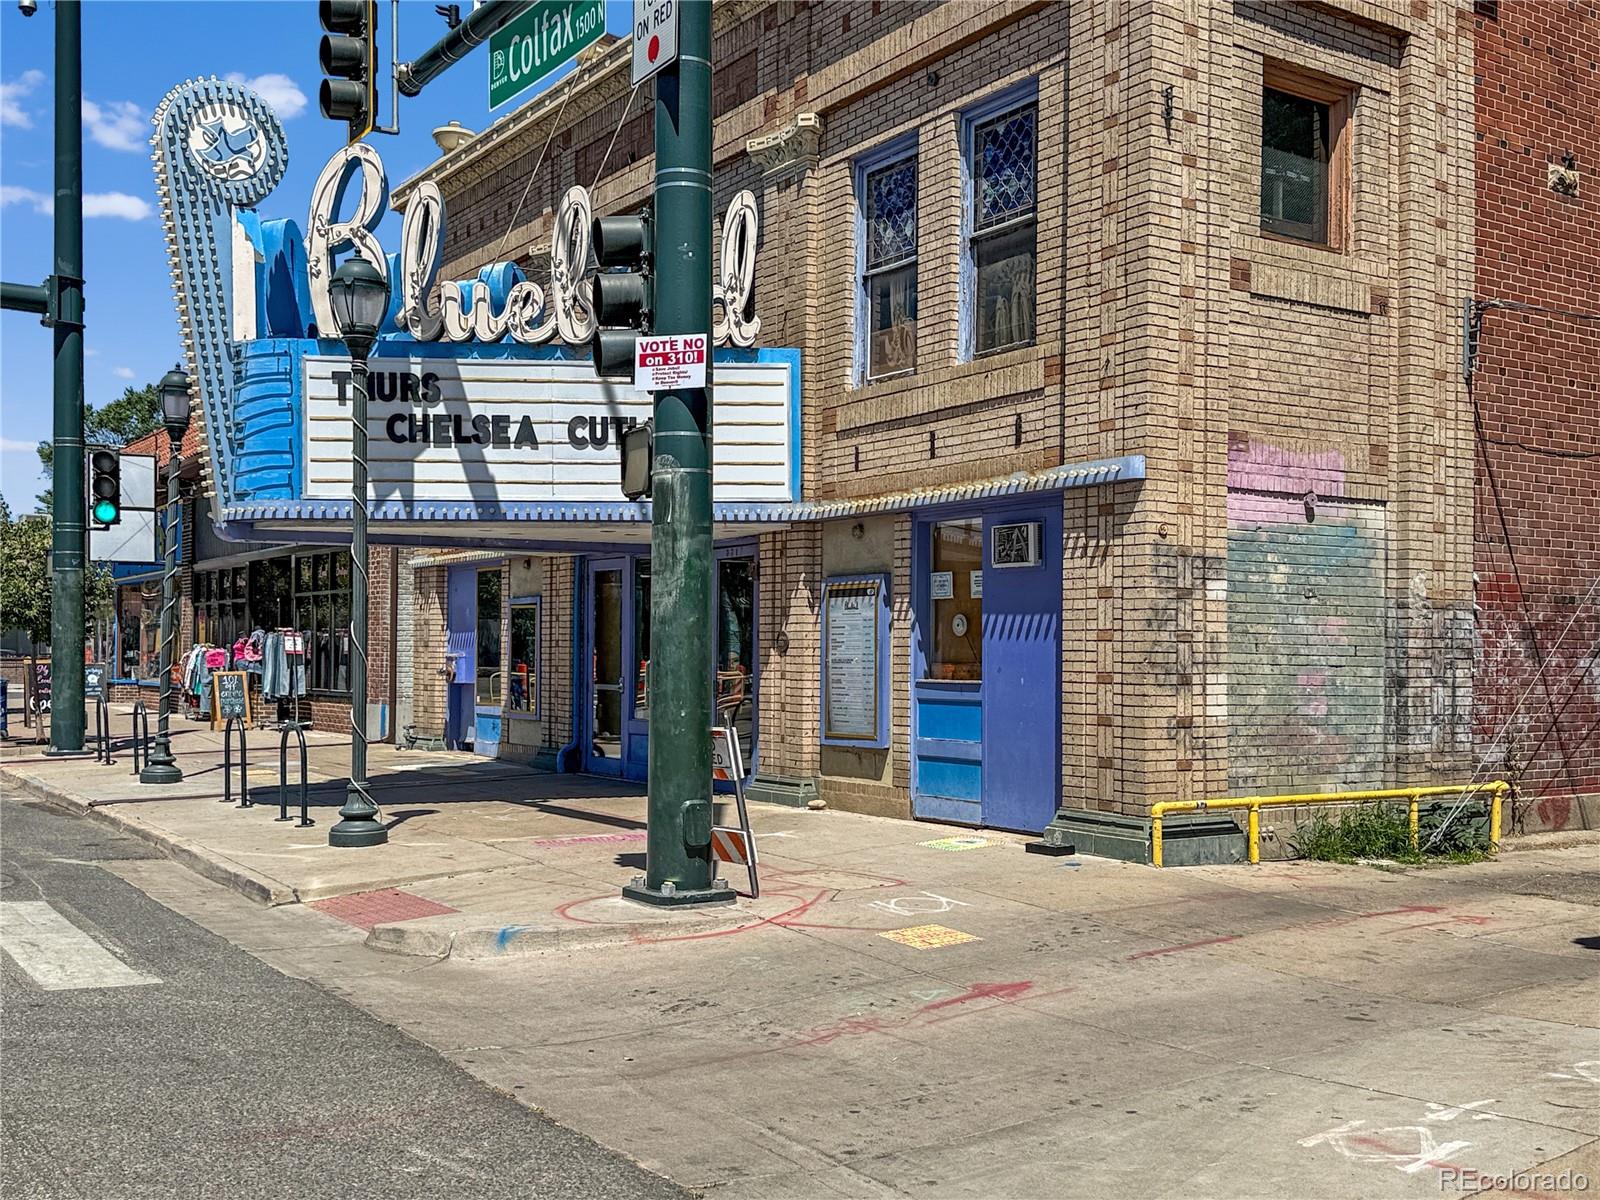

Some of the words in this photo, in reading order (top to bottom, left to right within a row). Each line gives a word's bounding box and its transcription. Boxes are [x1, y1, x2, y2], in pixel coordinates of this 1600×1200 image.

[637, 16, 649, 41] ON
[653, 0, 672, 29] RED
[509, 3, 574, 82] Colfax
[575, 6, 596, 40] 1500
[598, 2, 604, 24] N
[307, 142, 763, 348] Bluebd
[639, 340, 679, 353] VOTE
[683, 338, 705, 350] NO
[645, 356, 663, 366] on
[667, 352, 698, 364] 310!
[386, 414, 538, 448] CHELSEA
[225, 683, 237, 691] off
